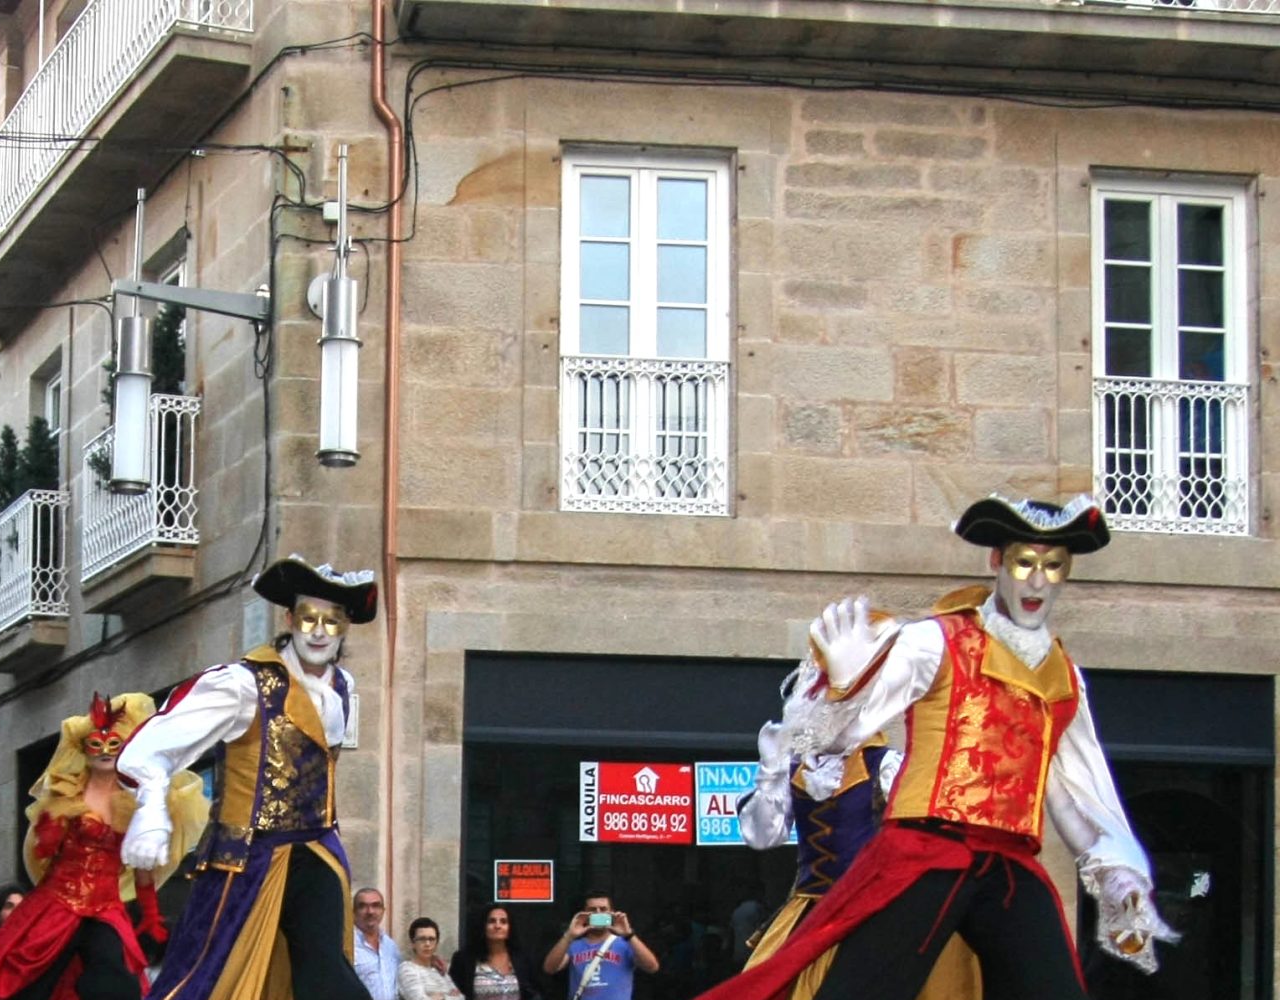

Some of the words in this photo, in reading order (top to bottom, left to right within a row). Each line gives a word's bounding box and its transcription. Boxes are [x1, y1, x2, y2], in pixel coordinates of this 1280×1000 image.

[699, 767, 751, 787] INMO
[584, 767, 596, 837] ALQUILA
[599, 794, 691, 806] FINCASCARRO
[706, 795, 735, 816] AL
[603, 812, 629, 831] 986
[631, 812, 648, 831] 86
[651, 813, 667, 832] 94
[670, 813, 688, 832] 92
[701, 818, 732, 836] 986
